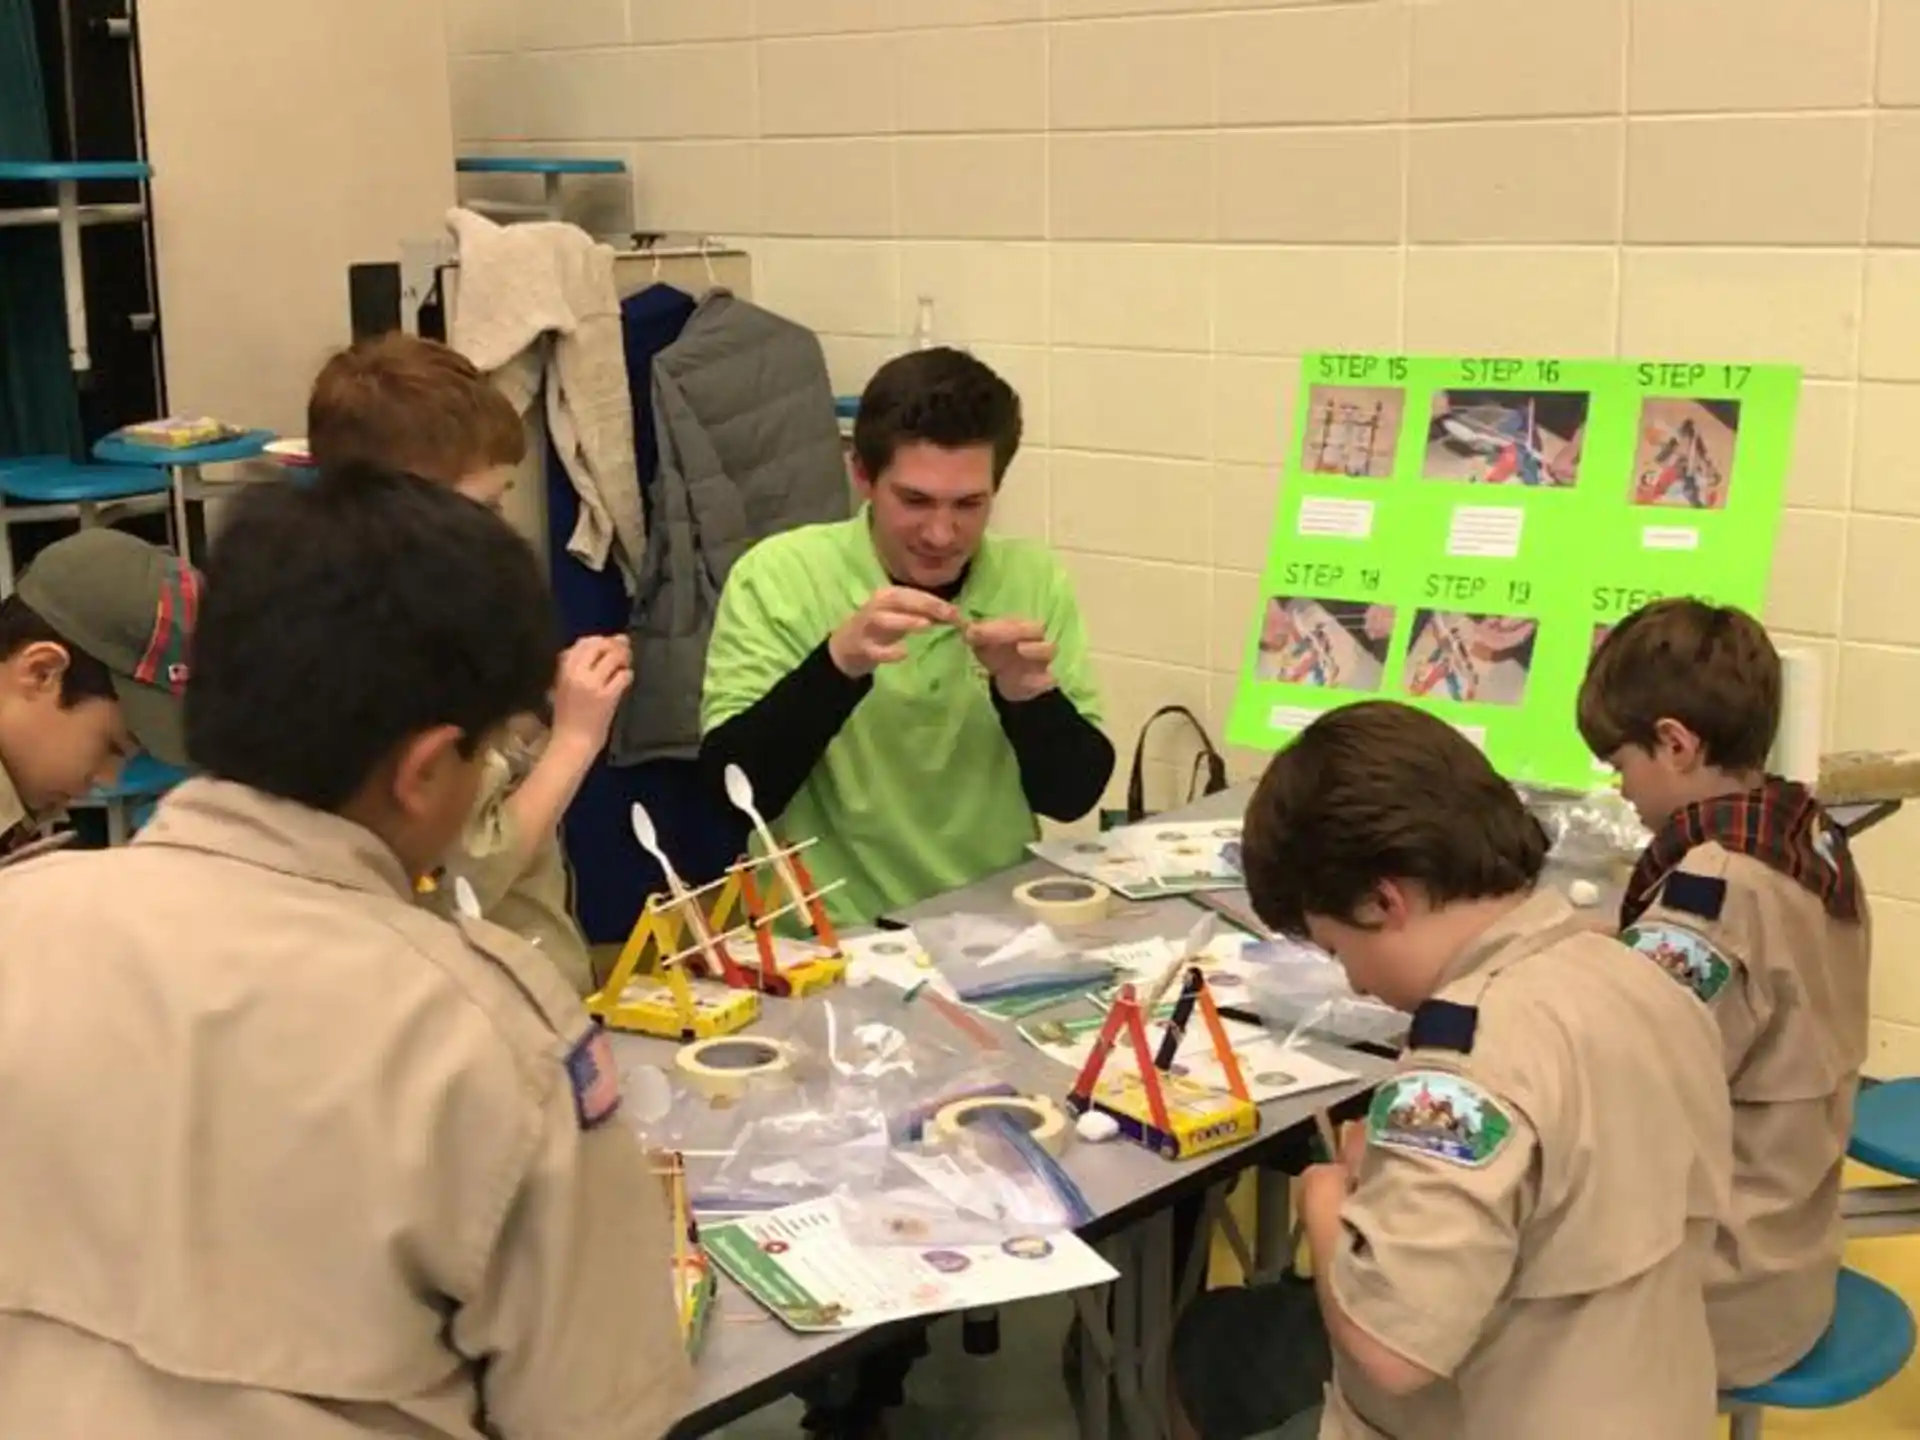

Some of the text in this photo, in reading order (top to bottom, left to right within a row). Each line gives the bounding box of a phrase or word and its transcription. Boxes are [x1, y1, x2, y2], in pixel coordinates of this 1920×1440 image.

[1319, 354, 1409, 381] STEP 15
[1460, 358, 1560, 384] STEP 16
[1638, 362, 1752, 389] STEP 17
[1284, 563, 1344, 589] STEP
[1424, 573, 1532, 605] STEP 19
